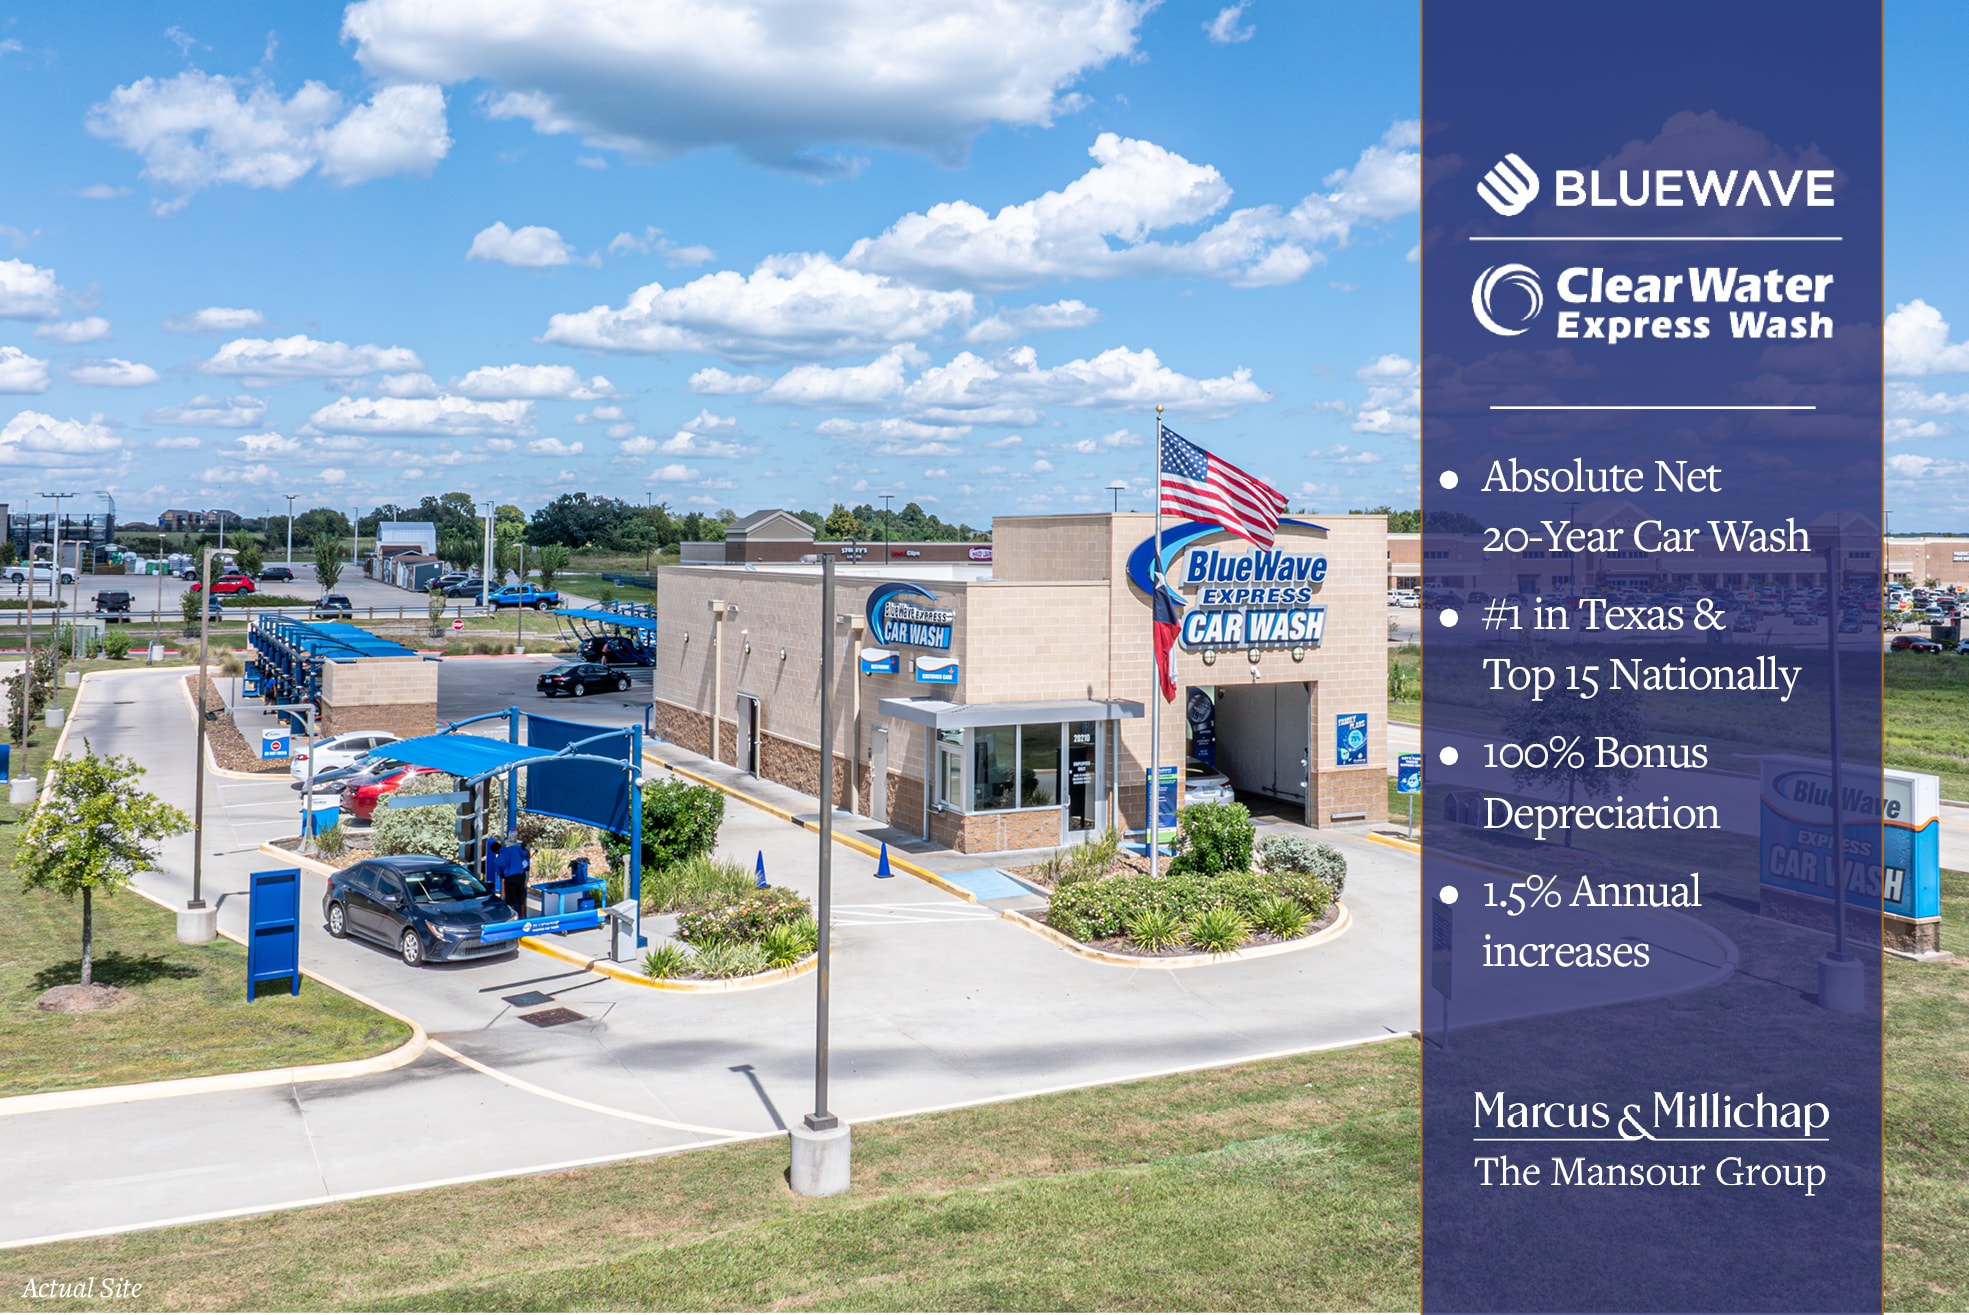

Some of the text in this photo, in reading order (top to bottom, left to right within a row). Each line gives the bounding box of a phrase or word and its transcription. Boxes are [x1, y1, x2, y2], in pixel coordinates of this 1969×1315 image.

[1187, 550, 1328, 582] BlueWave
[1203, 587, 1312, 605] EXPRESS
[884, 622, 944, 648] CAR WASH
[1188, 611, 1324, 643] CAR WASH
[1768, 845, 1818, 882] CAR
